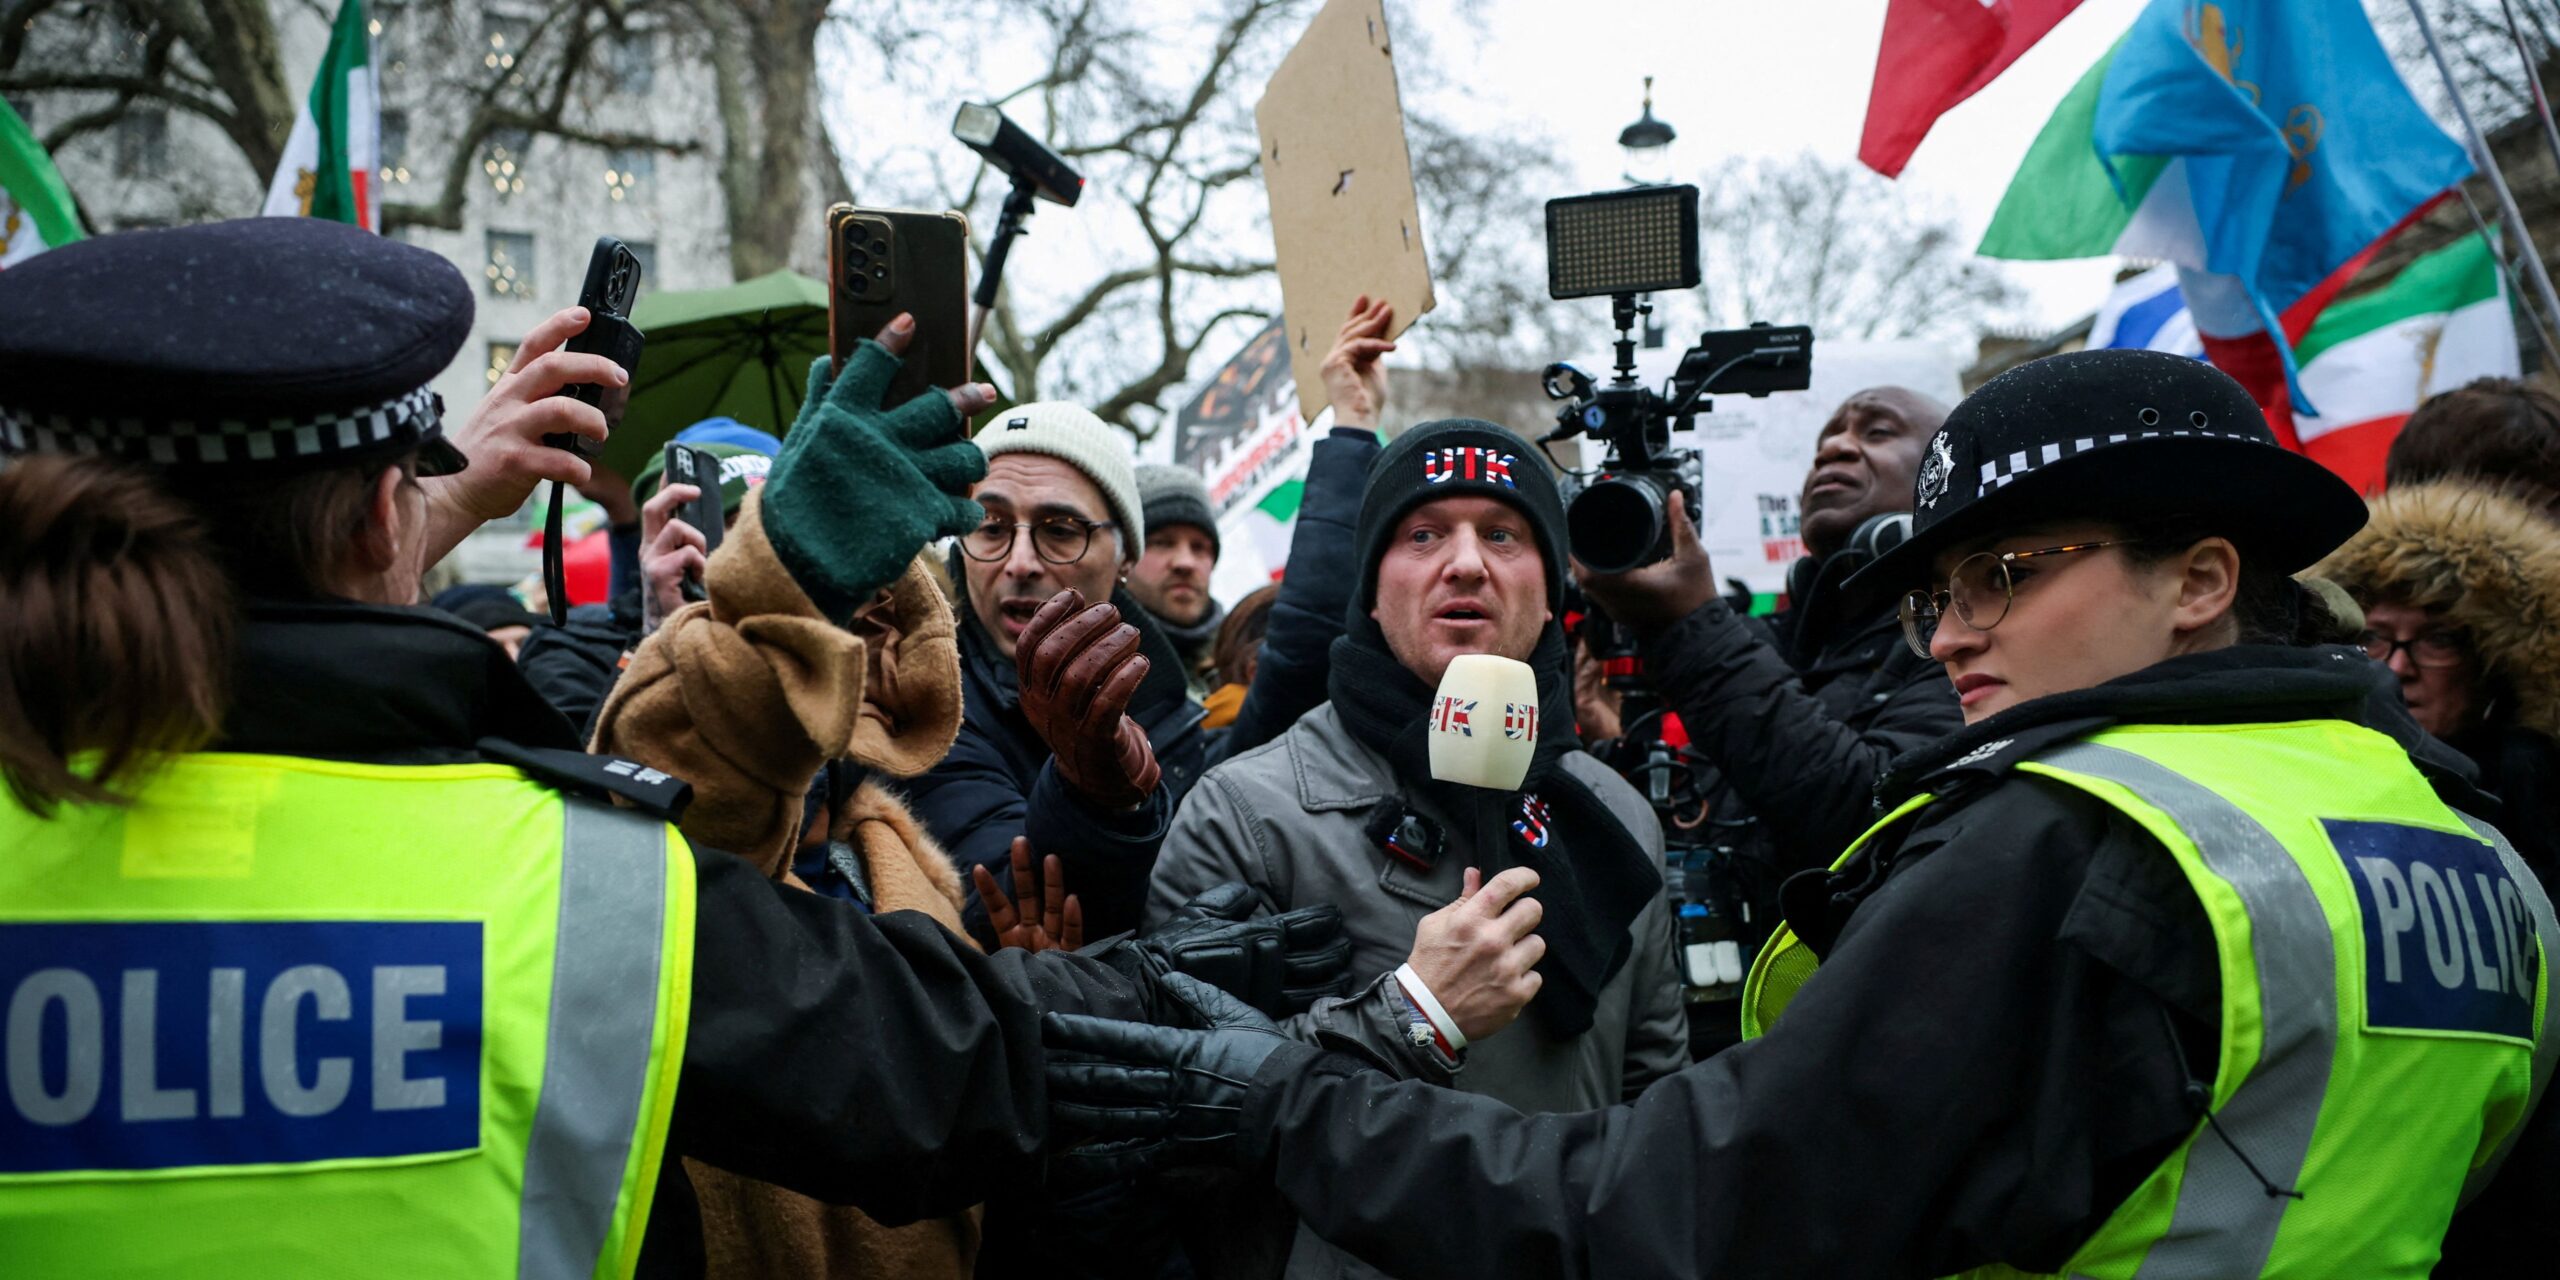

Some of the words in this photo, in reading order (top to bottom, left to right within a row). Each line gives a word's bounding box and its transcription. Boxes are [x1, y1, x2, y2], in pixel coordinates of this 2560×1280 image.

[1425, 447, 1518, 489] UTK
[1505, 702, 1539, 742] UT
[6, 964, 447, 1126] OLICE
